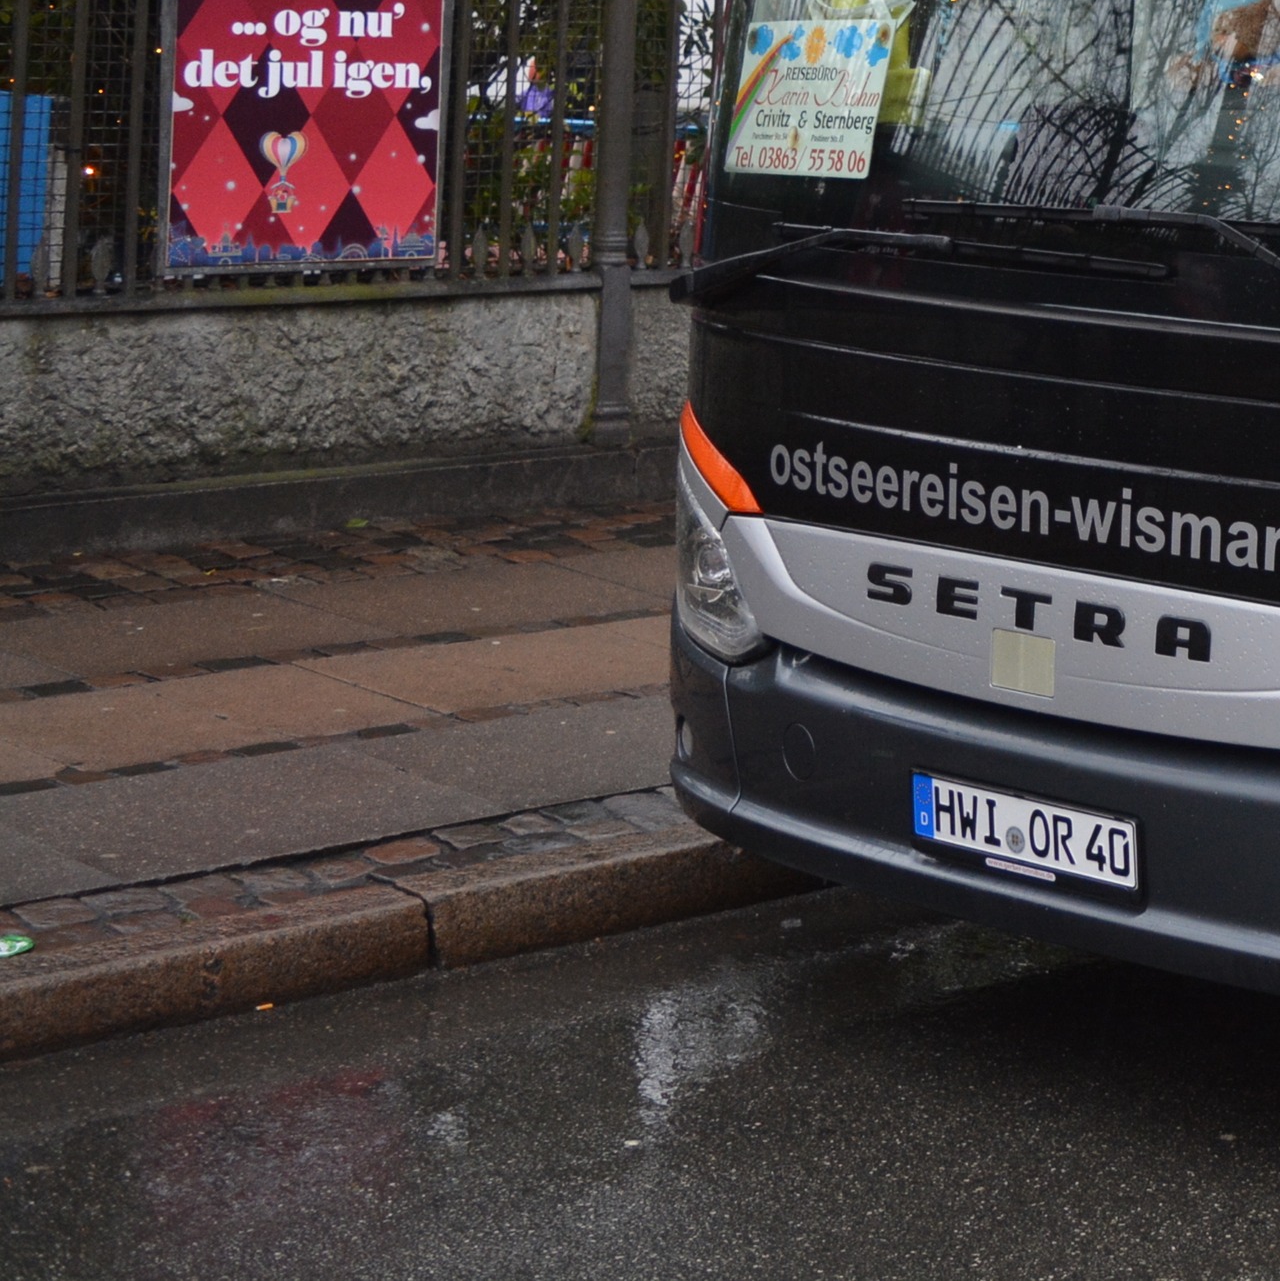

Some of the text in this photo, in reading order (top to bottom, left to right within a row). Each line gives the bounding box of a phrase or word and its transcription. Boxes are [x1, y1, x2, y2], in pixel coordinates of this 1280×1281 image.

[273, 8, 330, 47] og
[183, 48, 432, 98] det jul igen,
[754, 68, 880, 107] Karin Blohm
[784, 66, 838, 81] REISEBÜRO
[755, 109, 875, 135] Crivitz & Sternberg
[735, 145, 754, 168] Tel.
[808, 149, 824, 171] 55
[827, 150, 844, 172] 58
[848, 150, 866, 173] 06
[866, 562, 1212, 663] SETRA
[921, 812, 929, 826] D
[934, 786, 1130, 877] HWI OR 40
